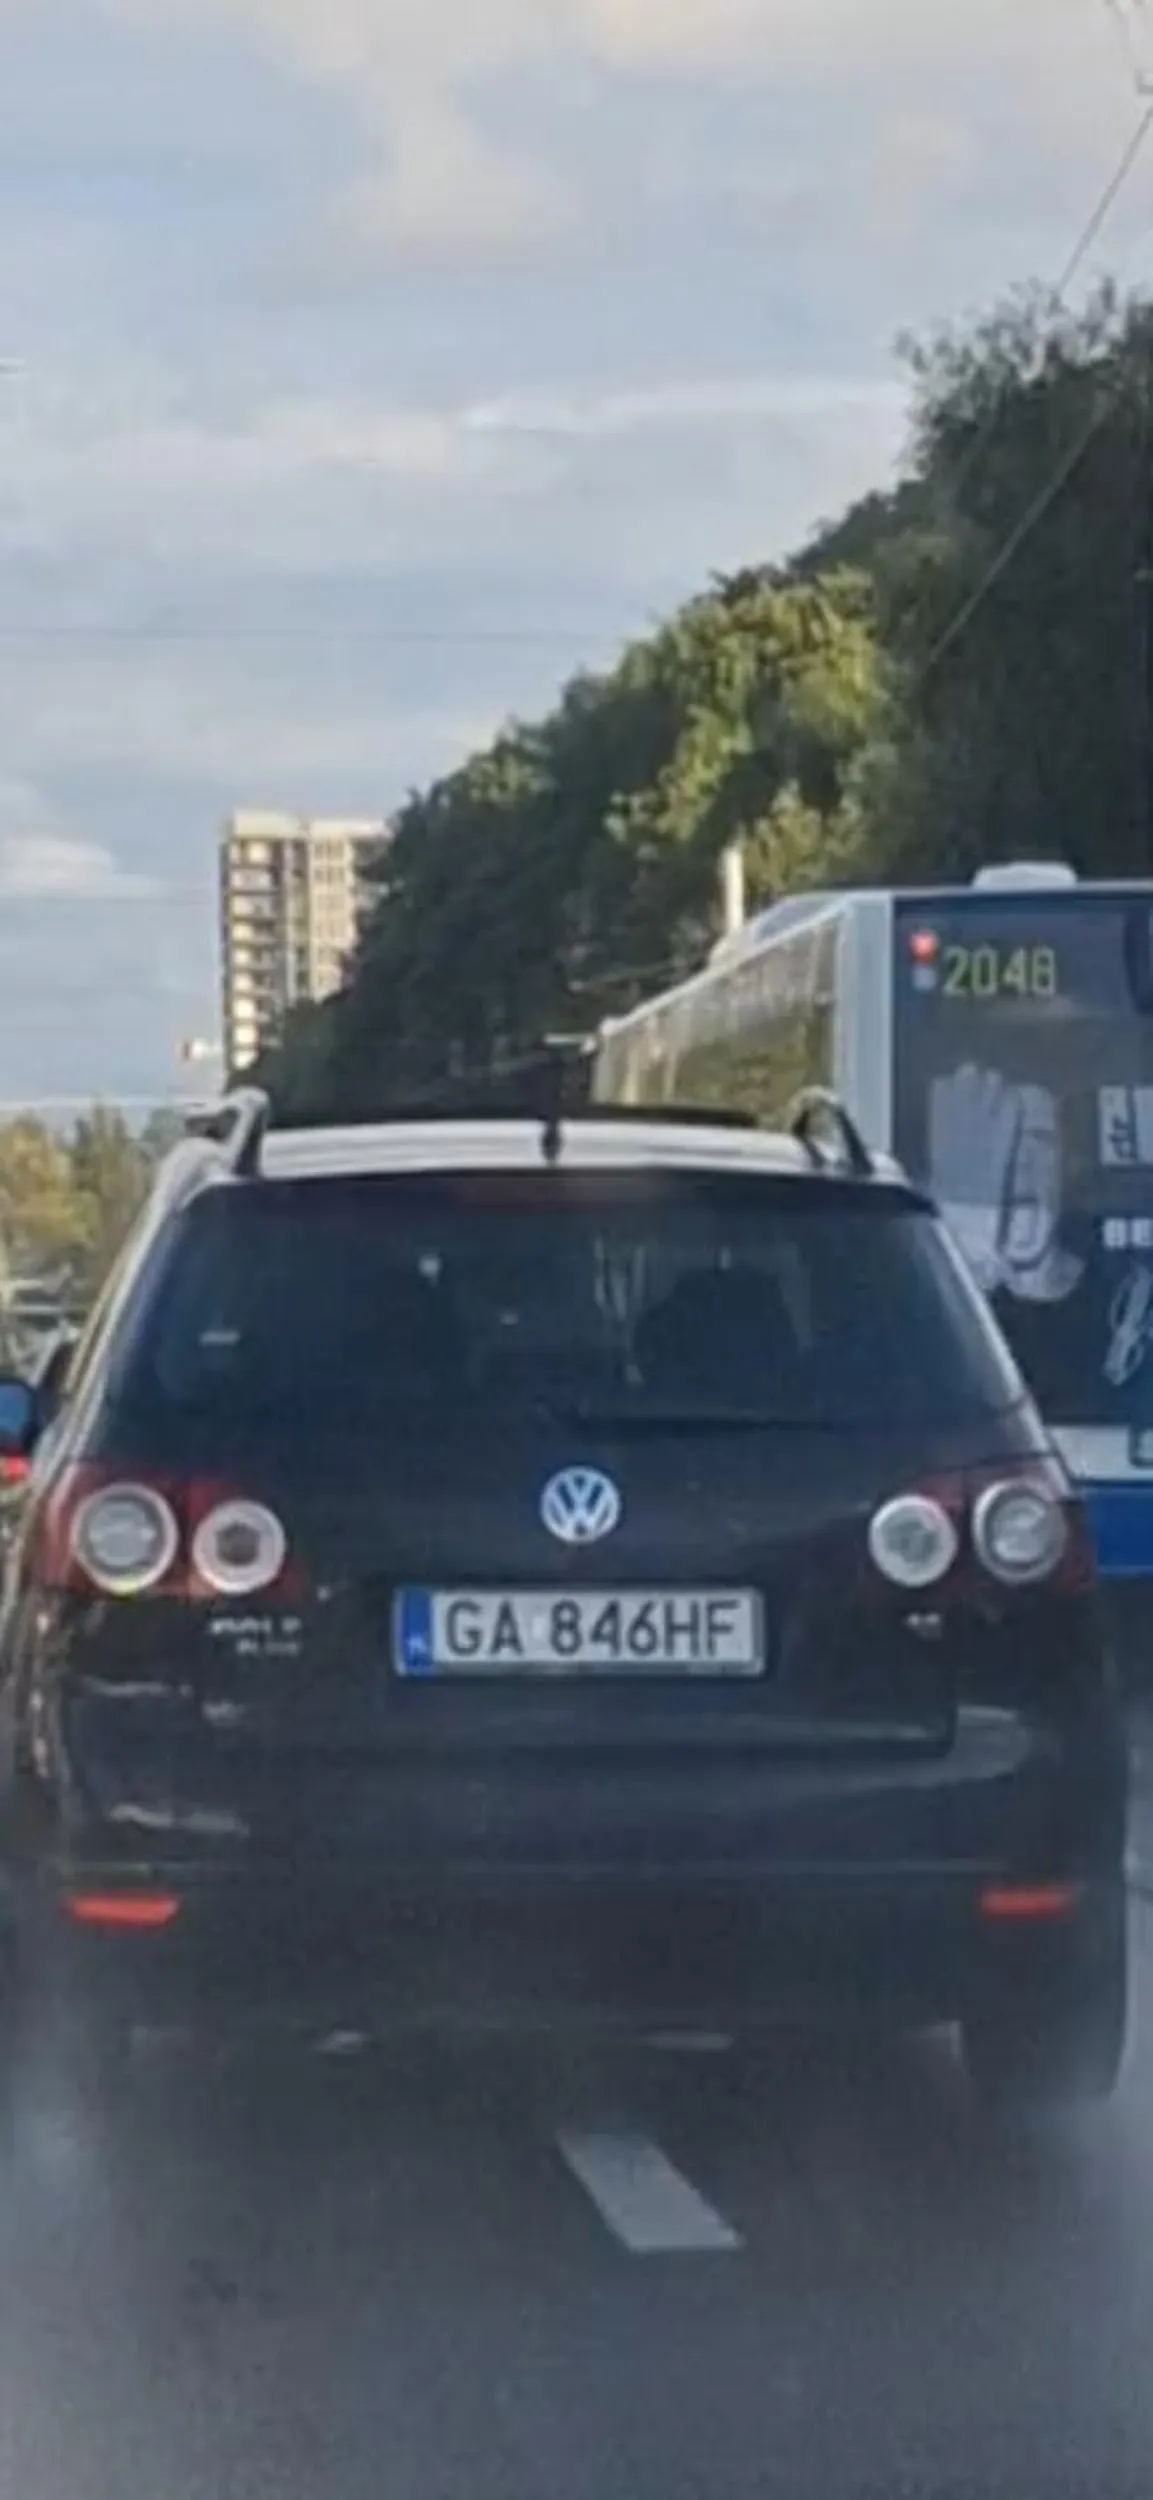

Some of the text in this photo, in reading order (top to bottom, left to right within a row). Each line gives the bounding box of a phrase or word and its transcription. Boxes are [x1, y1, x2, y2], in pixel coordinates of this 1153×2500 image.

[942, 946, 1056, 998] 2048
[445, 1599, 741, 1657] GA 846HF
